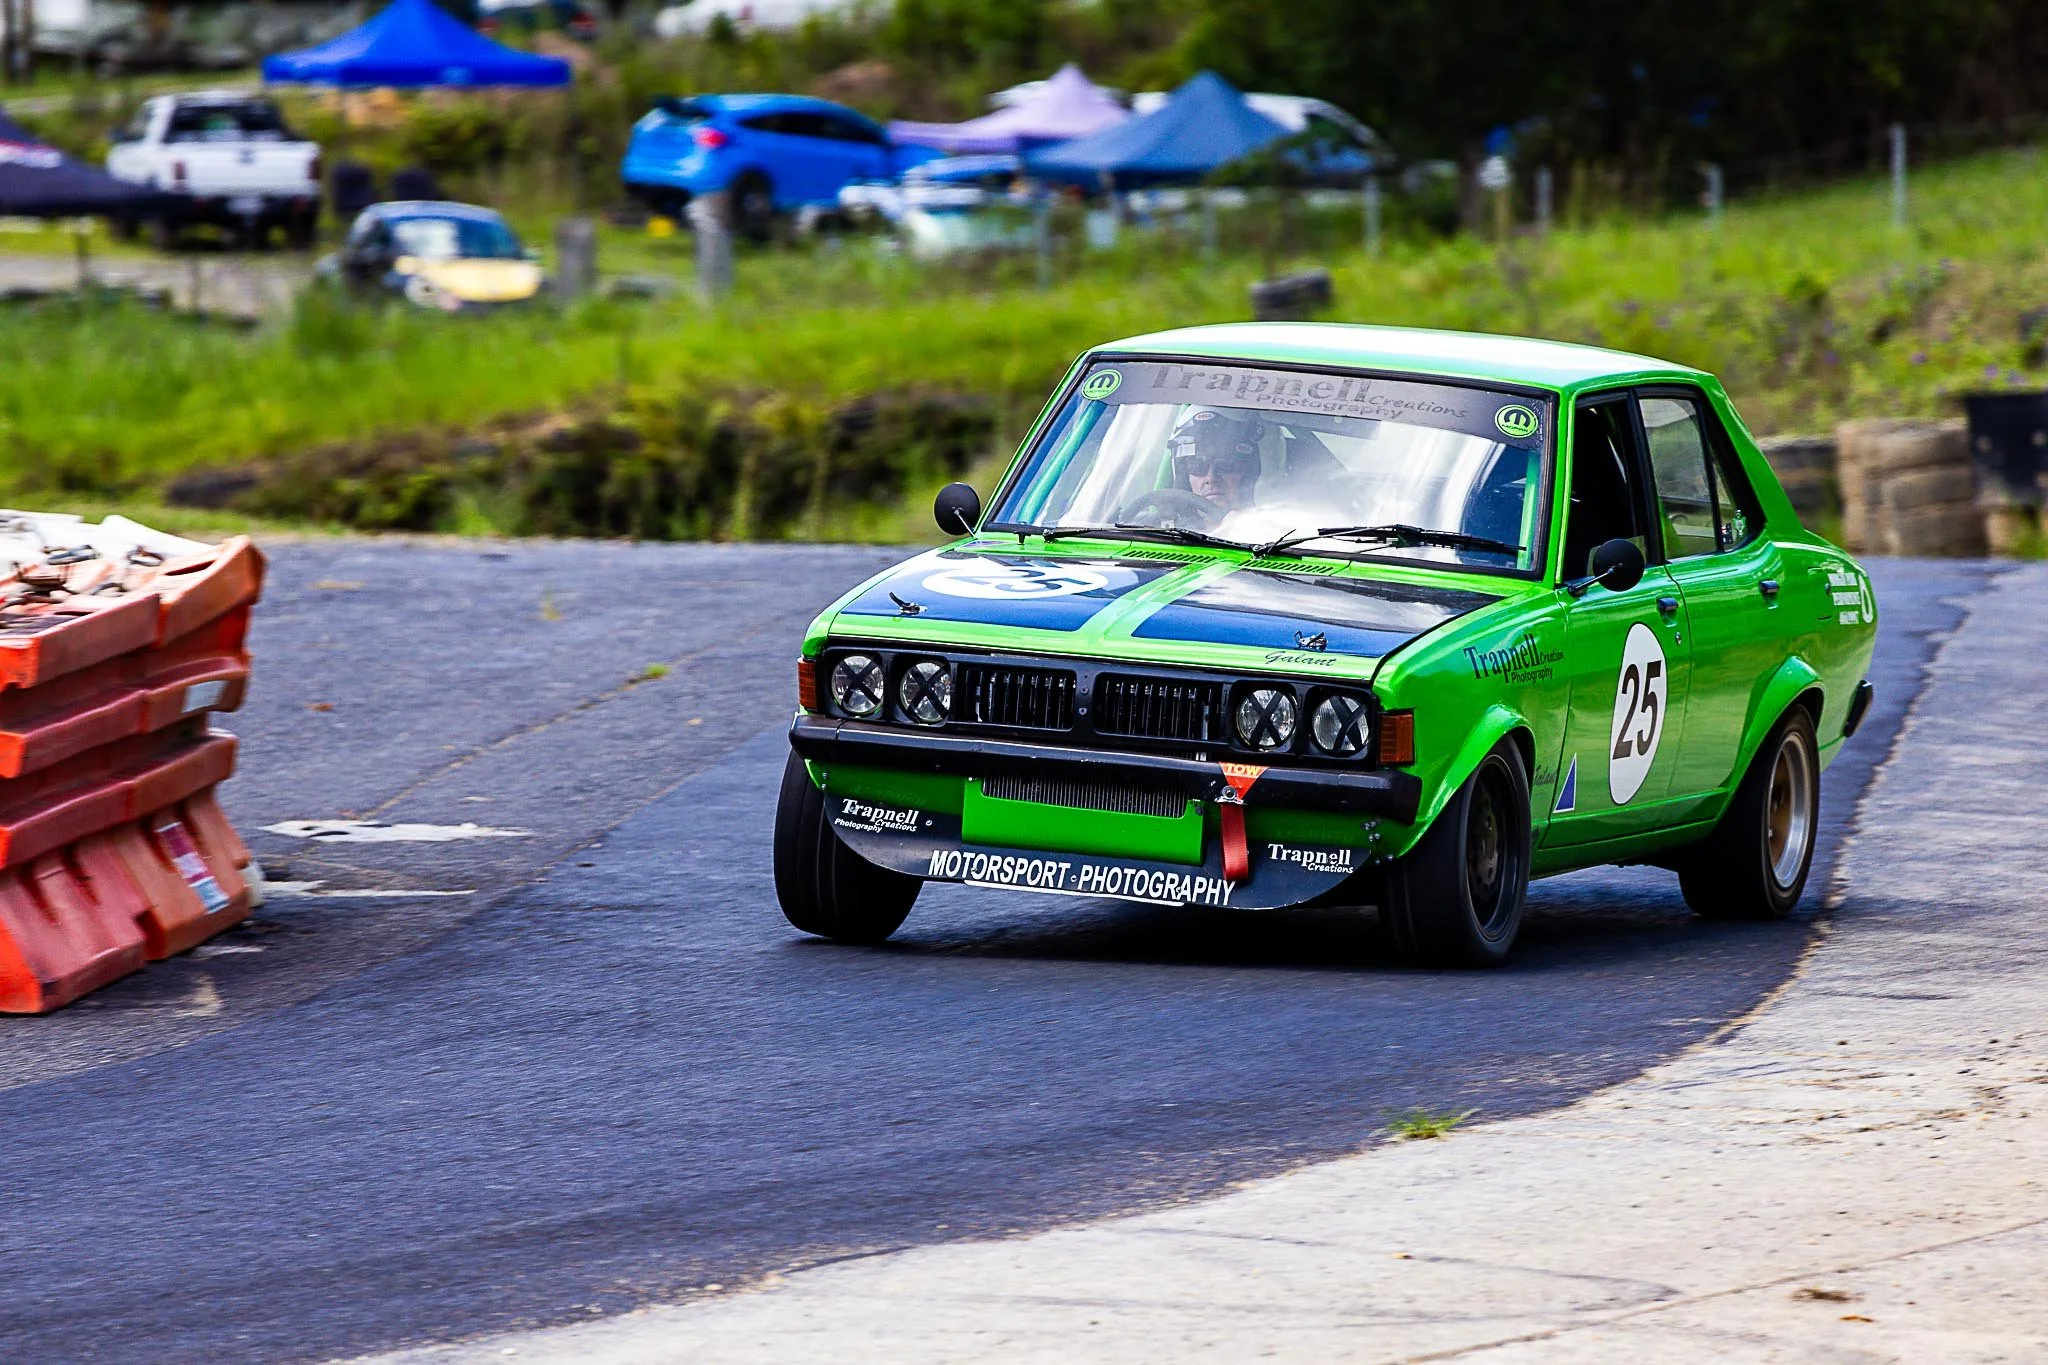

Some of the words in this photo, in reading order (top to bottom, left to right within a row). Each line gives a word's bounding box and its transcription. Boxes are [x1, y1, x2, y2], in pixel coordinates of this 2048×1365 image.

[1149, 364, 1372, 403] Trapnell
[1369, 394, 1467, 418] Creations
[1256, 394, 1403, 418] Photography
[1265, 650, 1337, 667] Galant
[1463, 633, 1541, 683] Trapnell
[1511, 667, 1553, 684] Photography
[1612, 659, 1662, 760] 25
[1225, 763, 1261, 777] TOW
[842, 798, 919, 825] Trapnell
[834, 817, 882, 834] Photography
[875, 818, 918, 832] Creations
[1267, 843, 1351, 867] Trapnell
[928, 850, 1071, 889] MOTORSPORT
[1077, 864, 1236, 907] PHOTOGRAPHY
[1307, 862, 1354, 874] Creations
